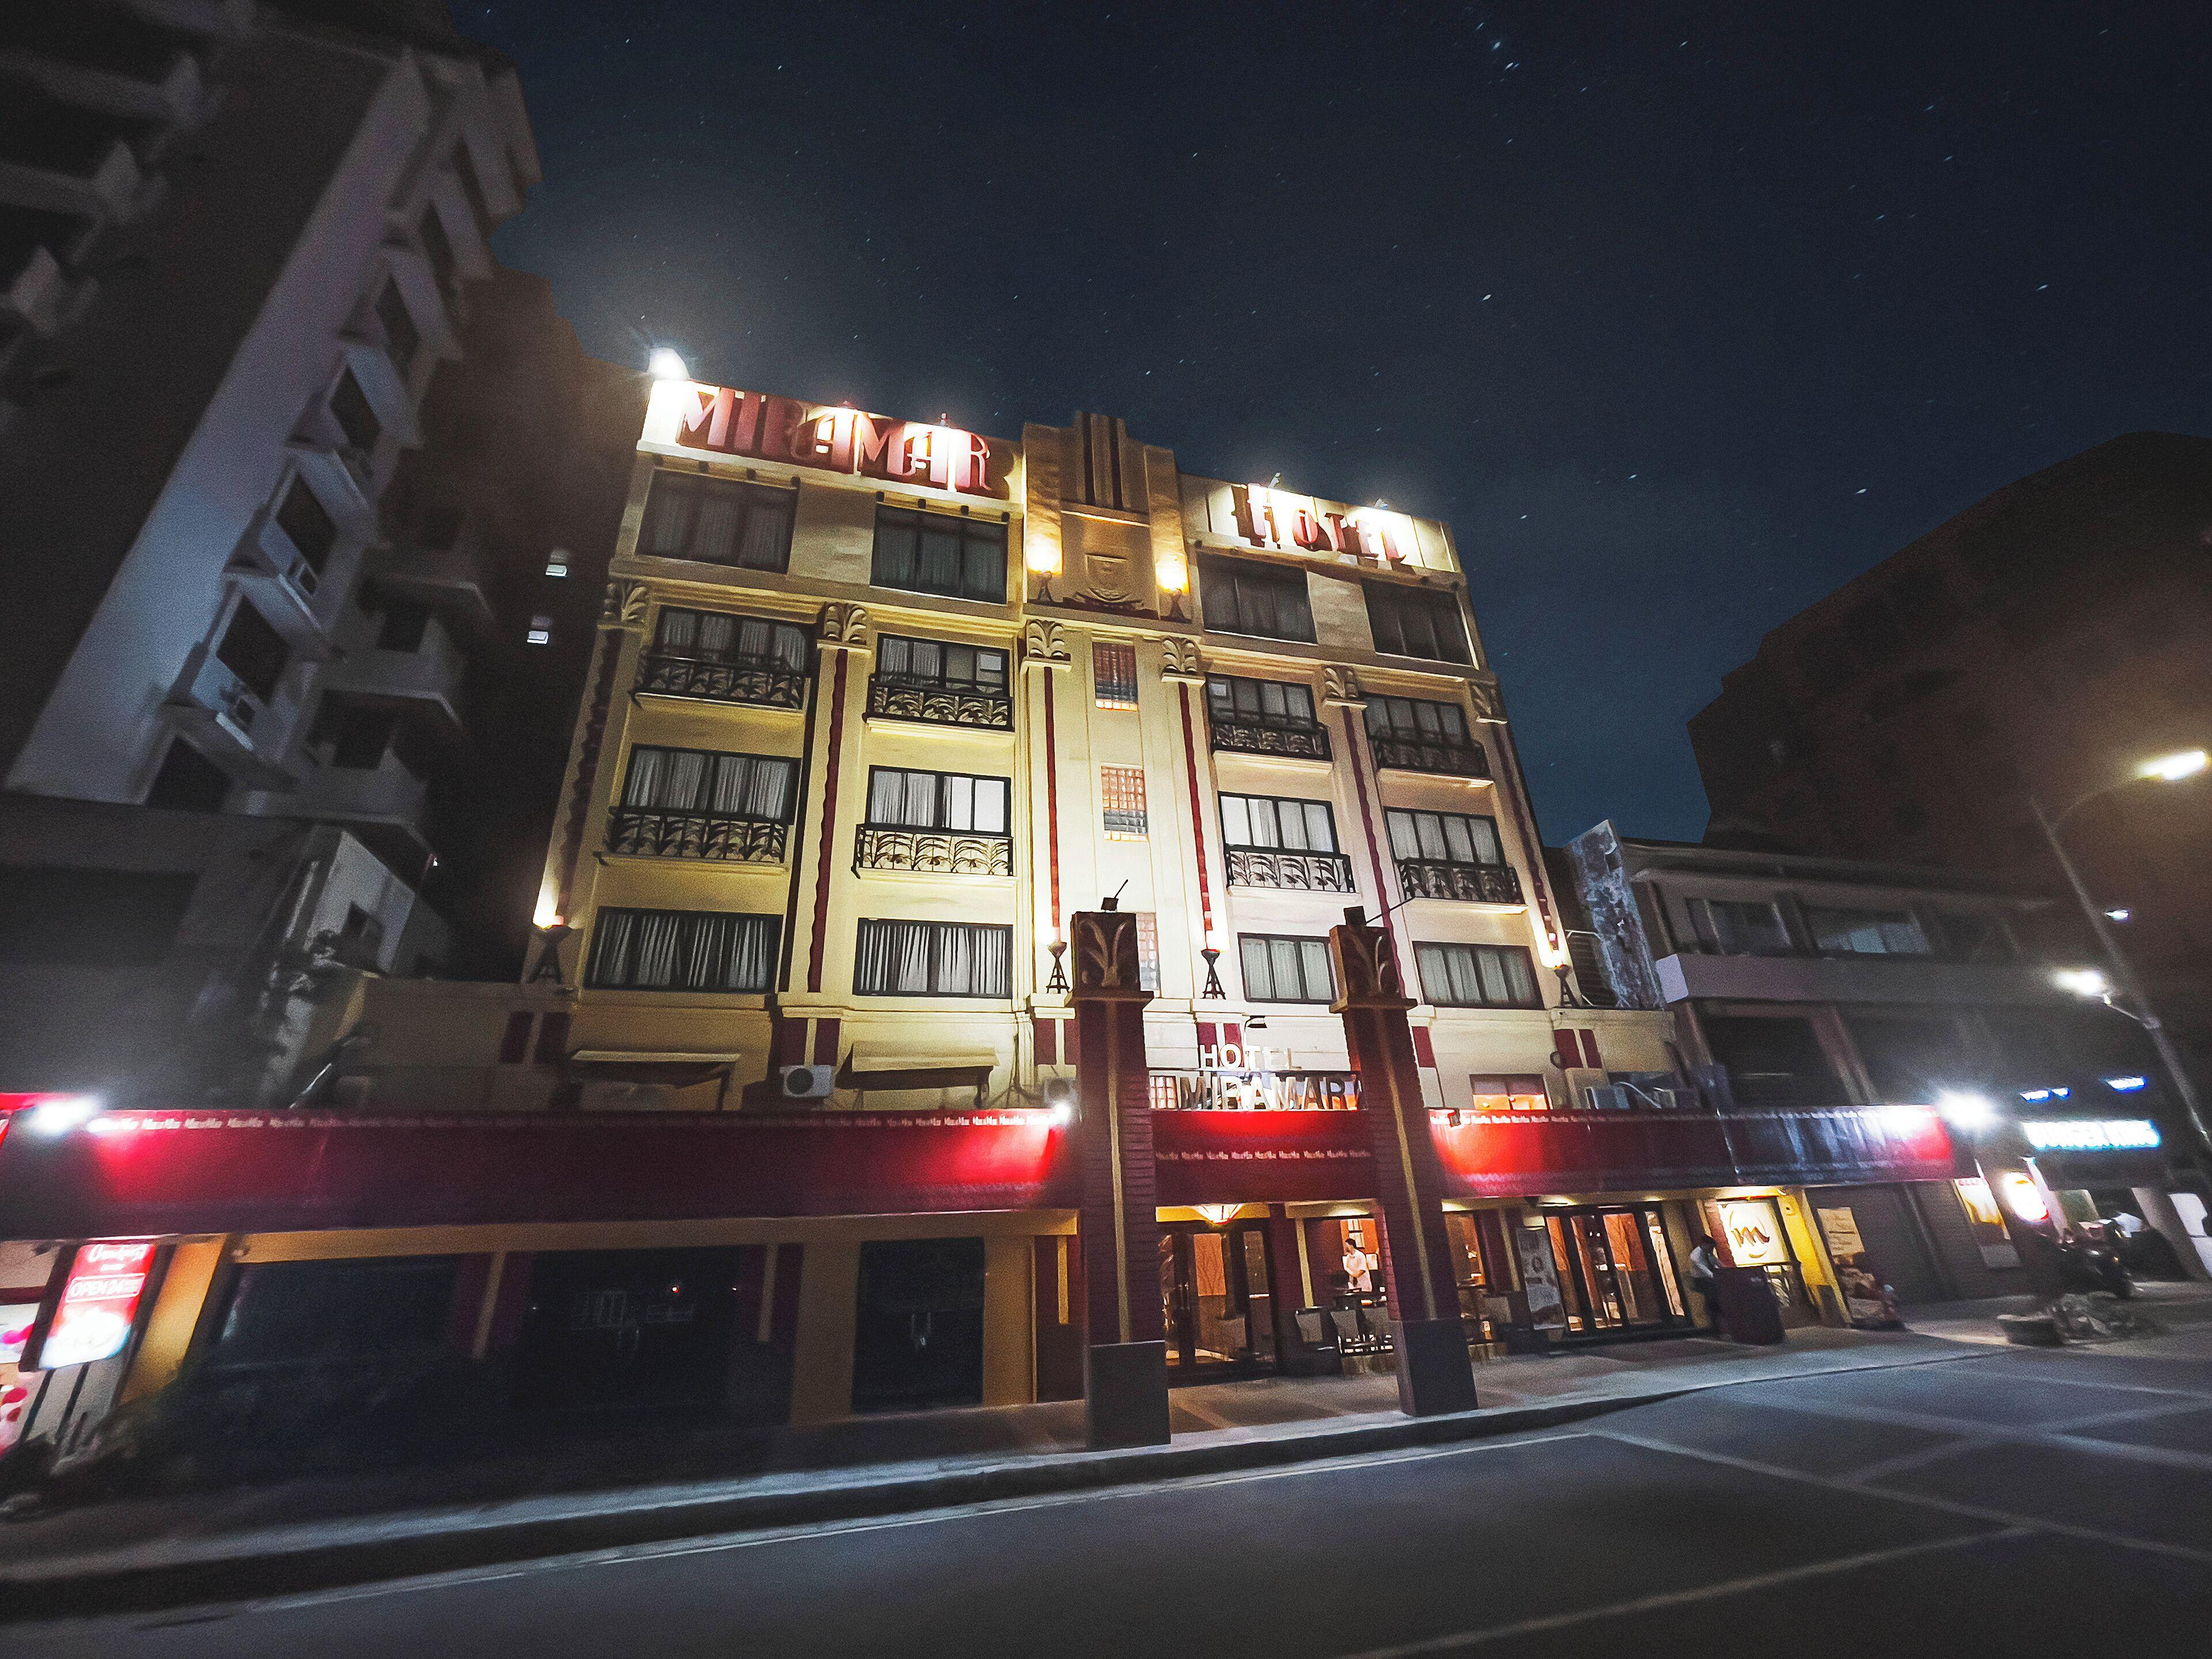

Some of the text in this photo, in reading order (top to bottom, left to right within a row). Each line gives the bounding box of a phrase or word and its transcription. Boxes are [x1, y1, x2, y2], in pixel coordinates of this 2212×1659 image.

[677, 385, 993, 492] MIRAMAR
[1247, 483, 1407, 563] HOTEL
[1199, 1043, 1302, 1070] HOTEL
[1179, 1075, 1350, 1111] MIRAMAR
